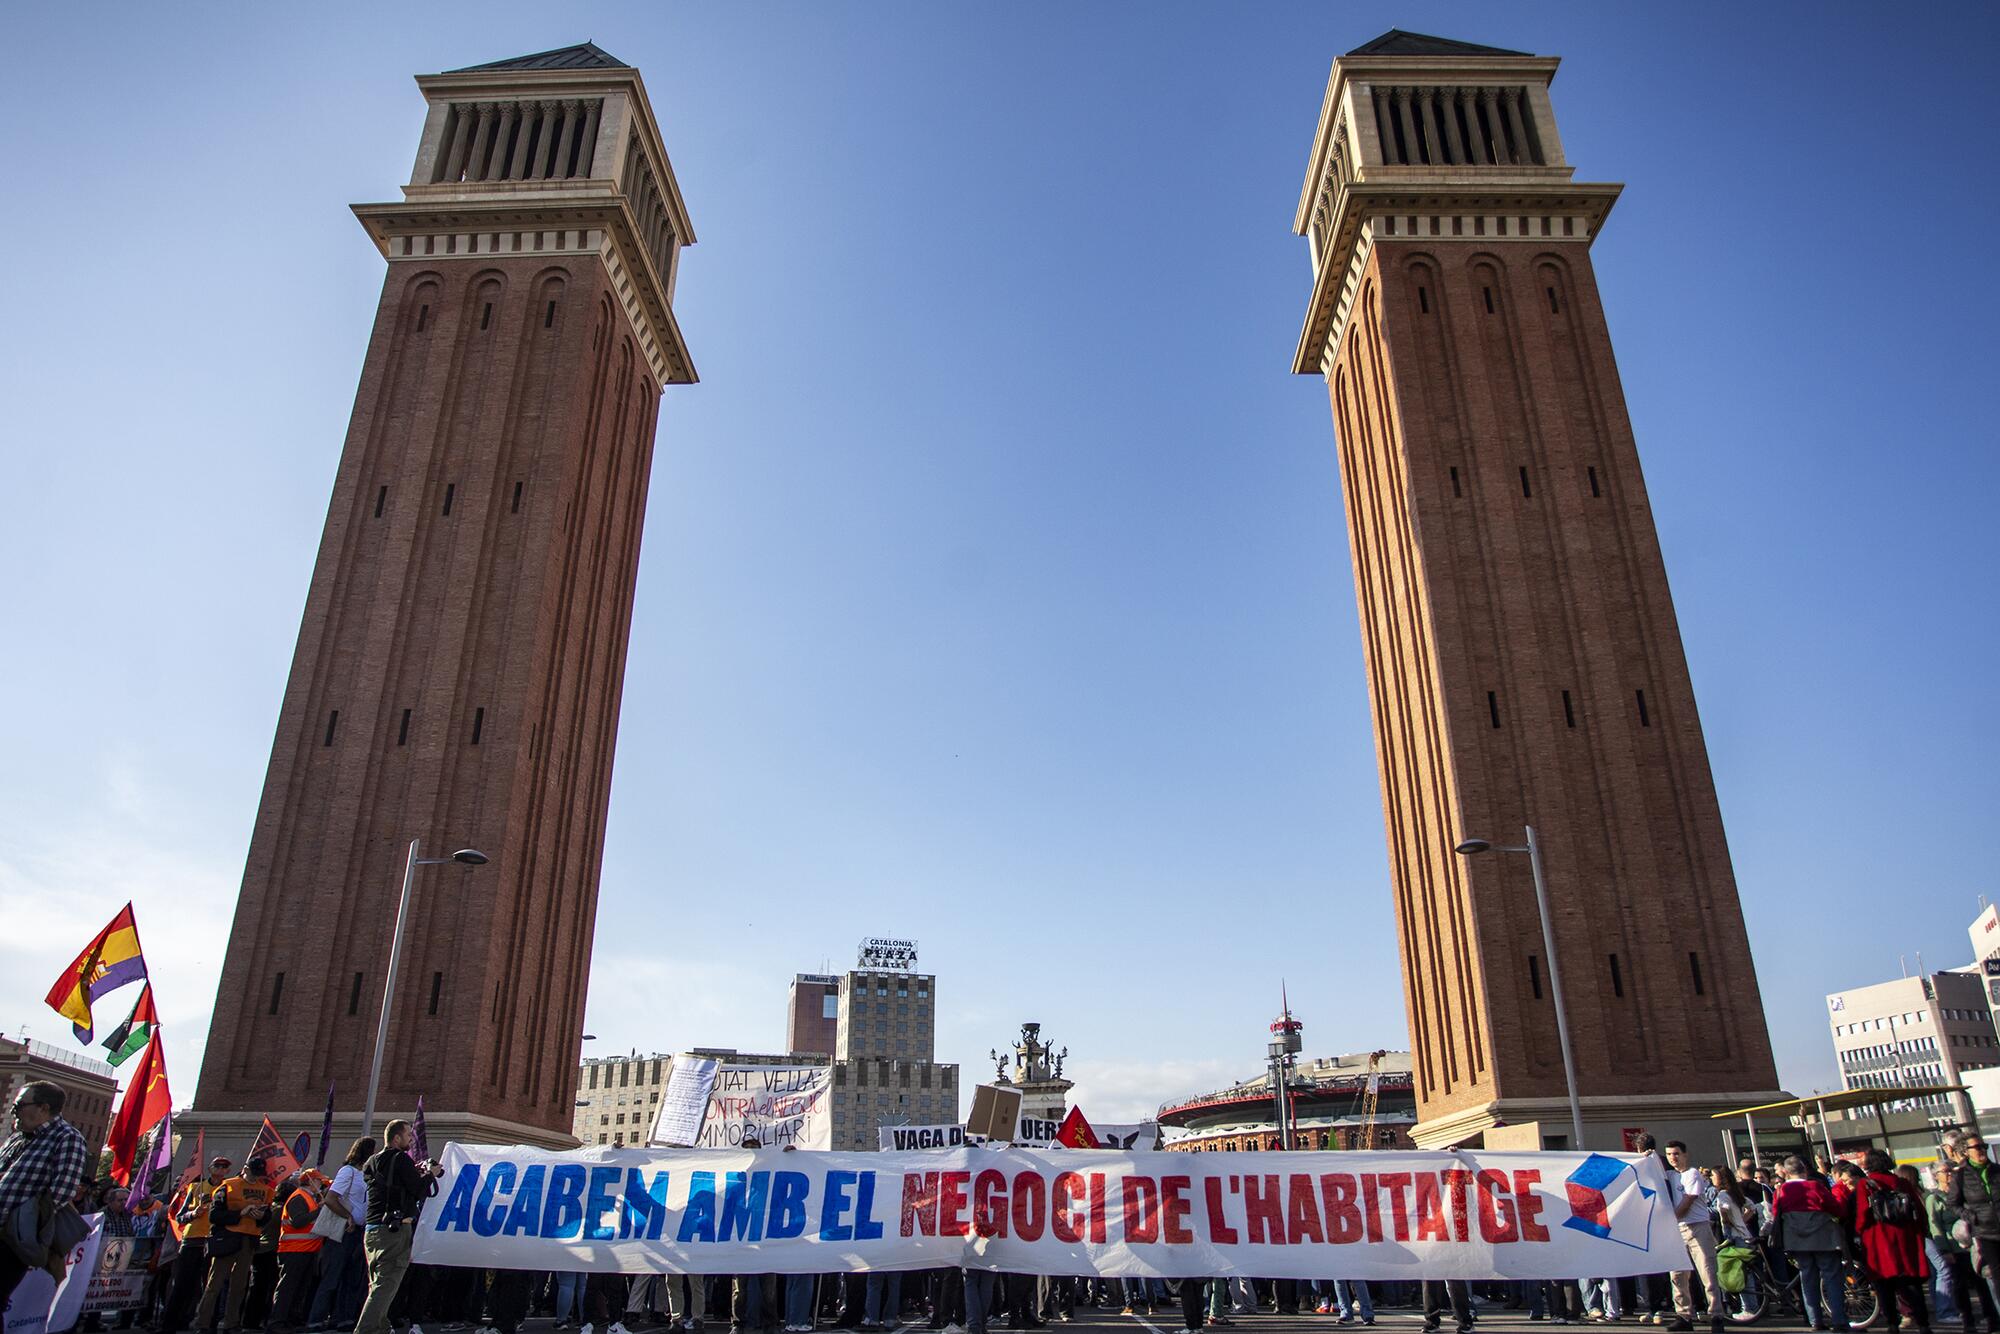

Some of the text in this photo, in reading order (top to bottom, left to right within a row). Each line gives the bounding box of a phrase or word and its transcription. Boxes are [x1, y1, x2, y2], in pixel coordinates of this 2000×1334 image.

[870, 939, 913, 947] CATALONIA
[864, 948, 917, 960] PLAZA
[803, 975, 829, 983] Allianz
[761, 1069, 816, 1093] VELLA
[706, 1096, 759, 1120] ONTRA
[893, 1127, 944, 1150] VAGA
[435, 1160, 1551, 1245] ACABEM AMB EL NEGOCI DE L'HABITATGE
[65, 1247, 84, 1265] LS
